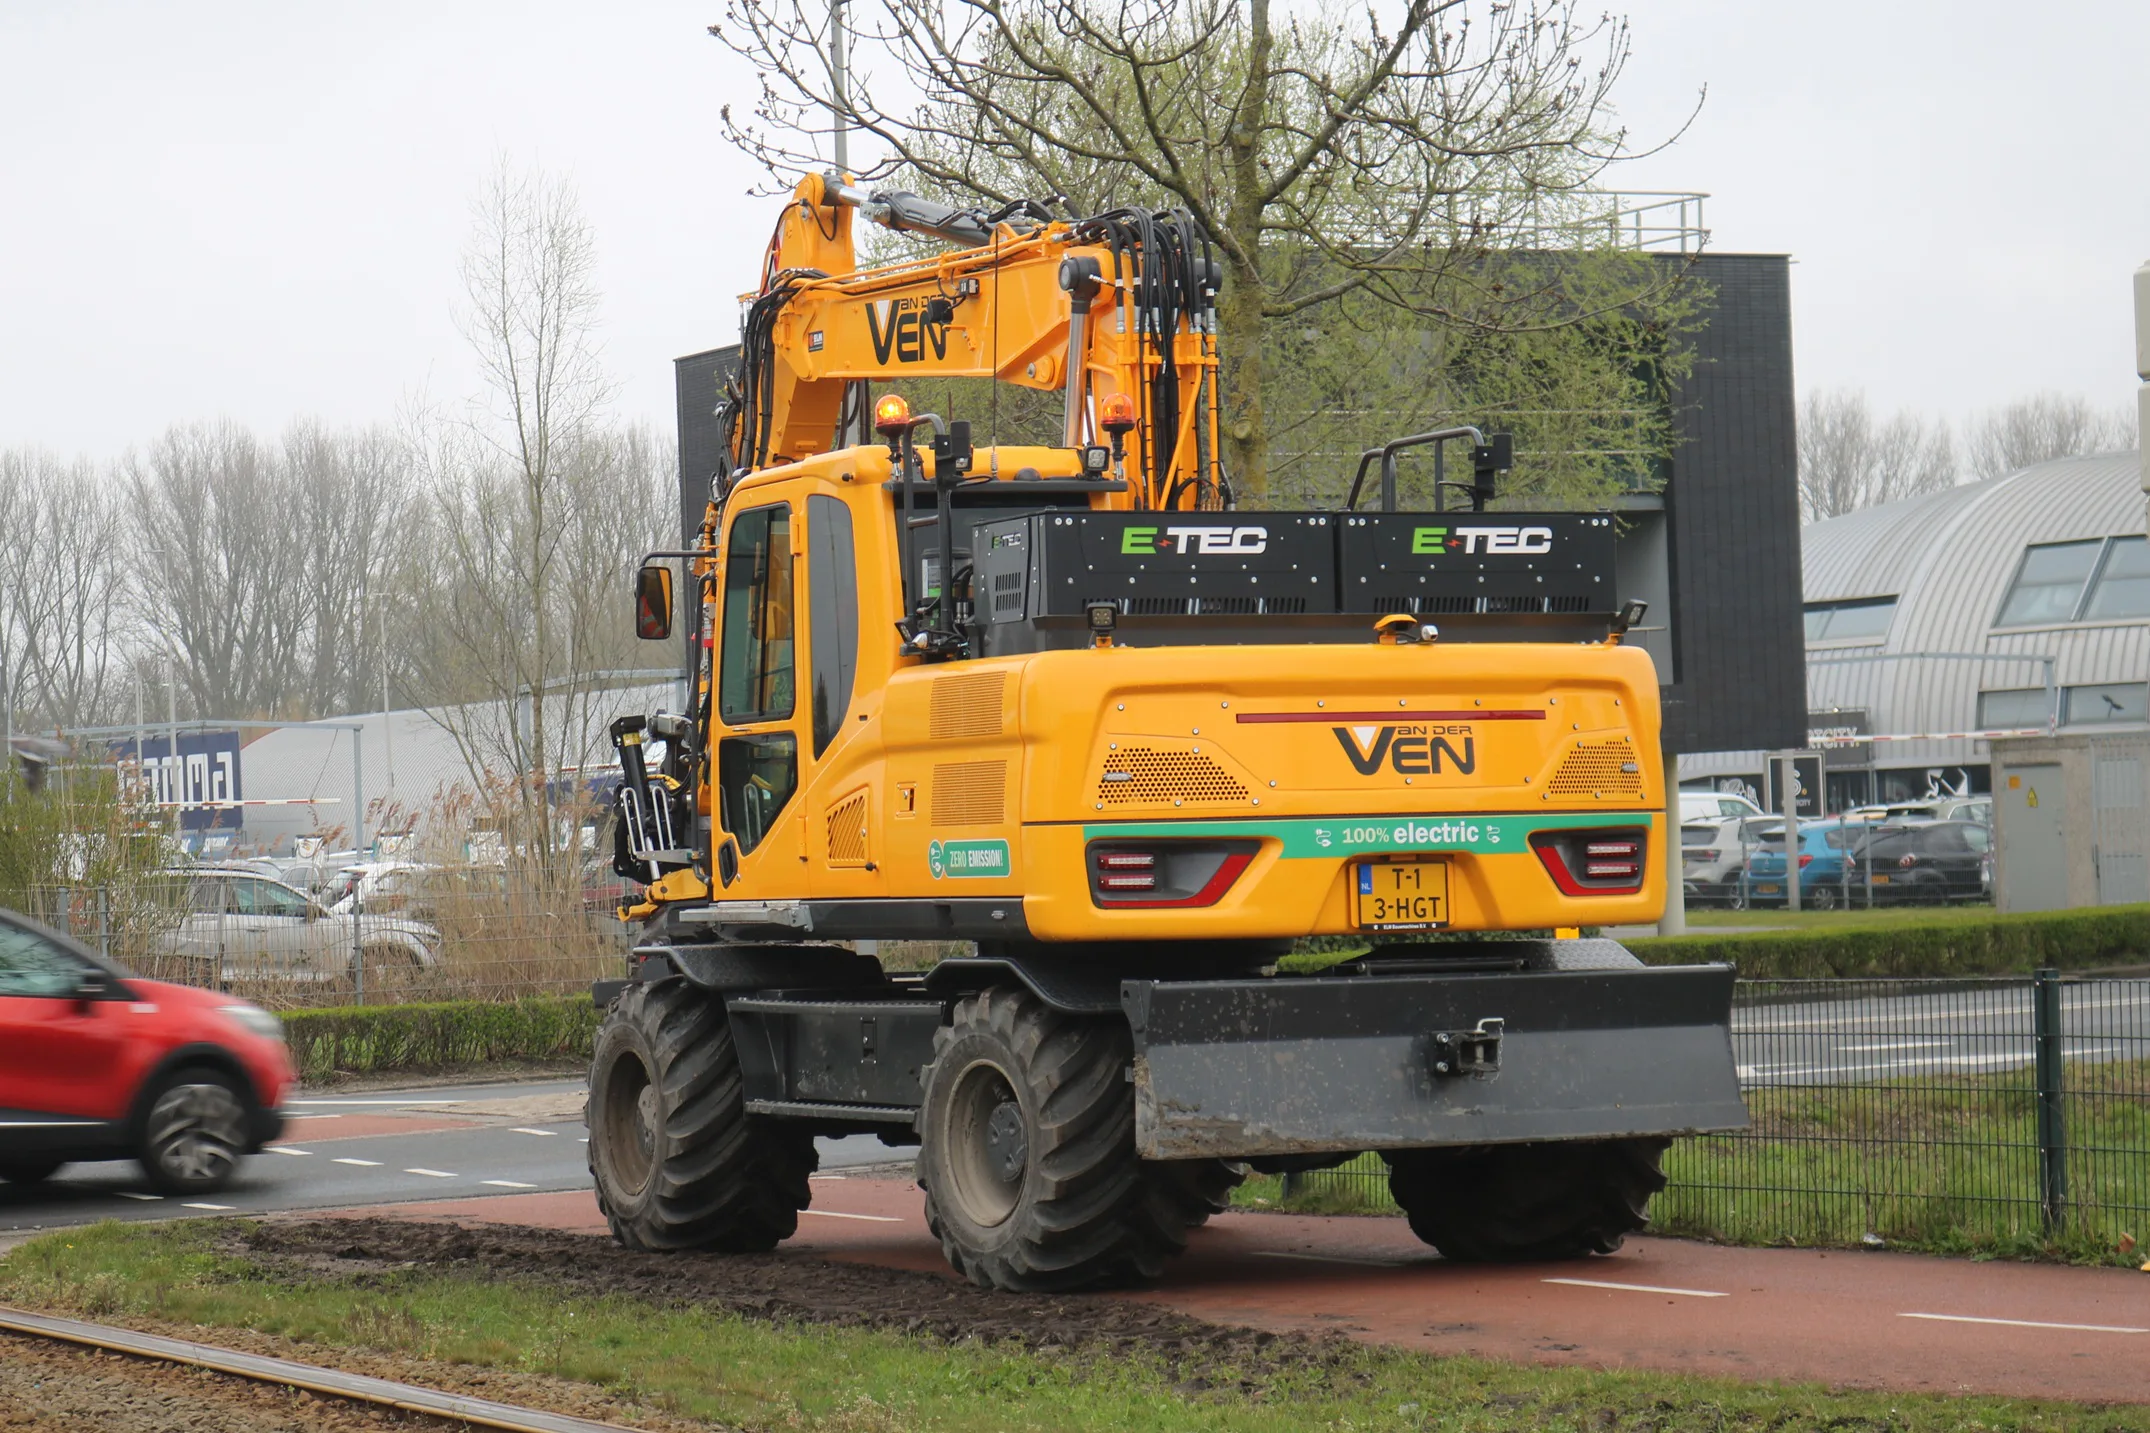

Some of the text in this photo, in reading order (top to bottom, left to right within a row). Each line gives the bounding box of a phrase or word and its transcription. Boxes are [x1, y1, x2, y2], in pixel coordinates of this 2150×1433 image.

[1432, 725, 1473, 735] DER
[1331, 726, 1476, 776] VEN
[1342, 820, 1479, 844] 100% electric
[949, 849, 1004, 868] ZERO EMISSION!
[1361, 882, 1371, 891] NL
[1391, 868, 1420, 890] T-1
[1374, 896, 1441, 920] 3-HGT
